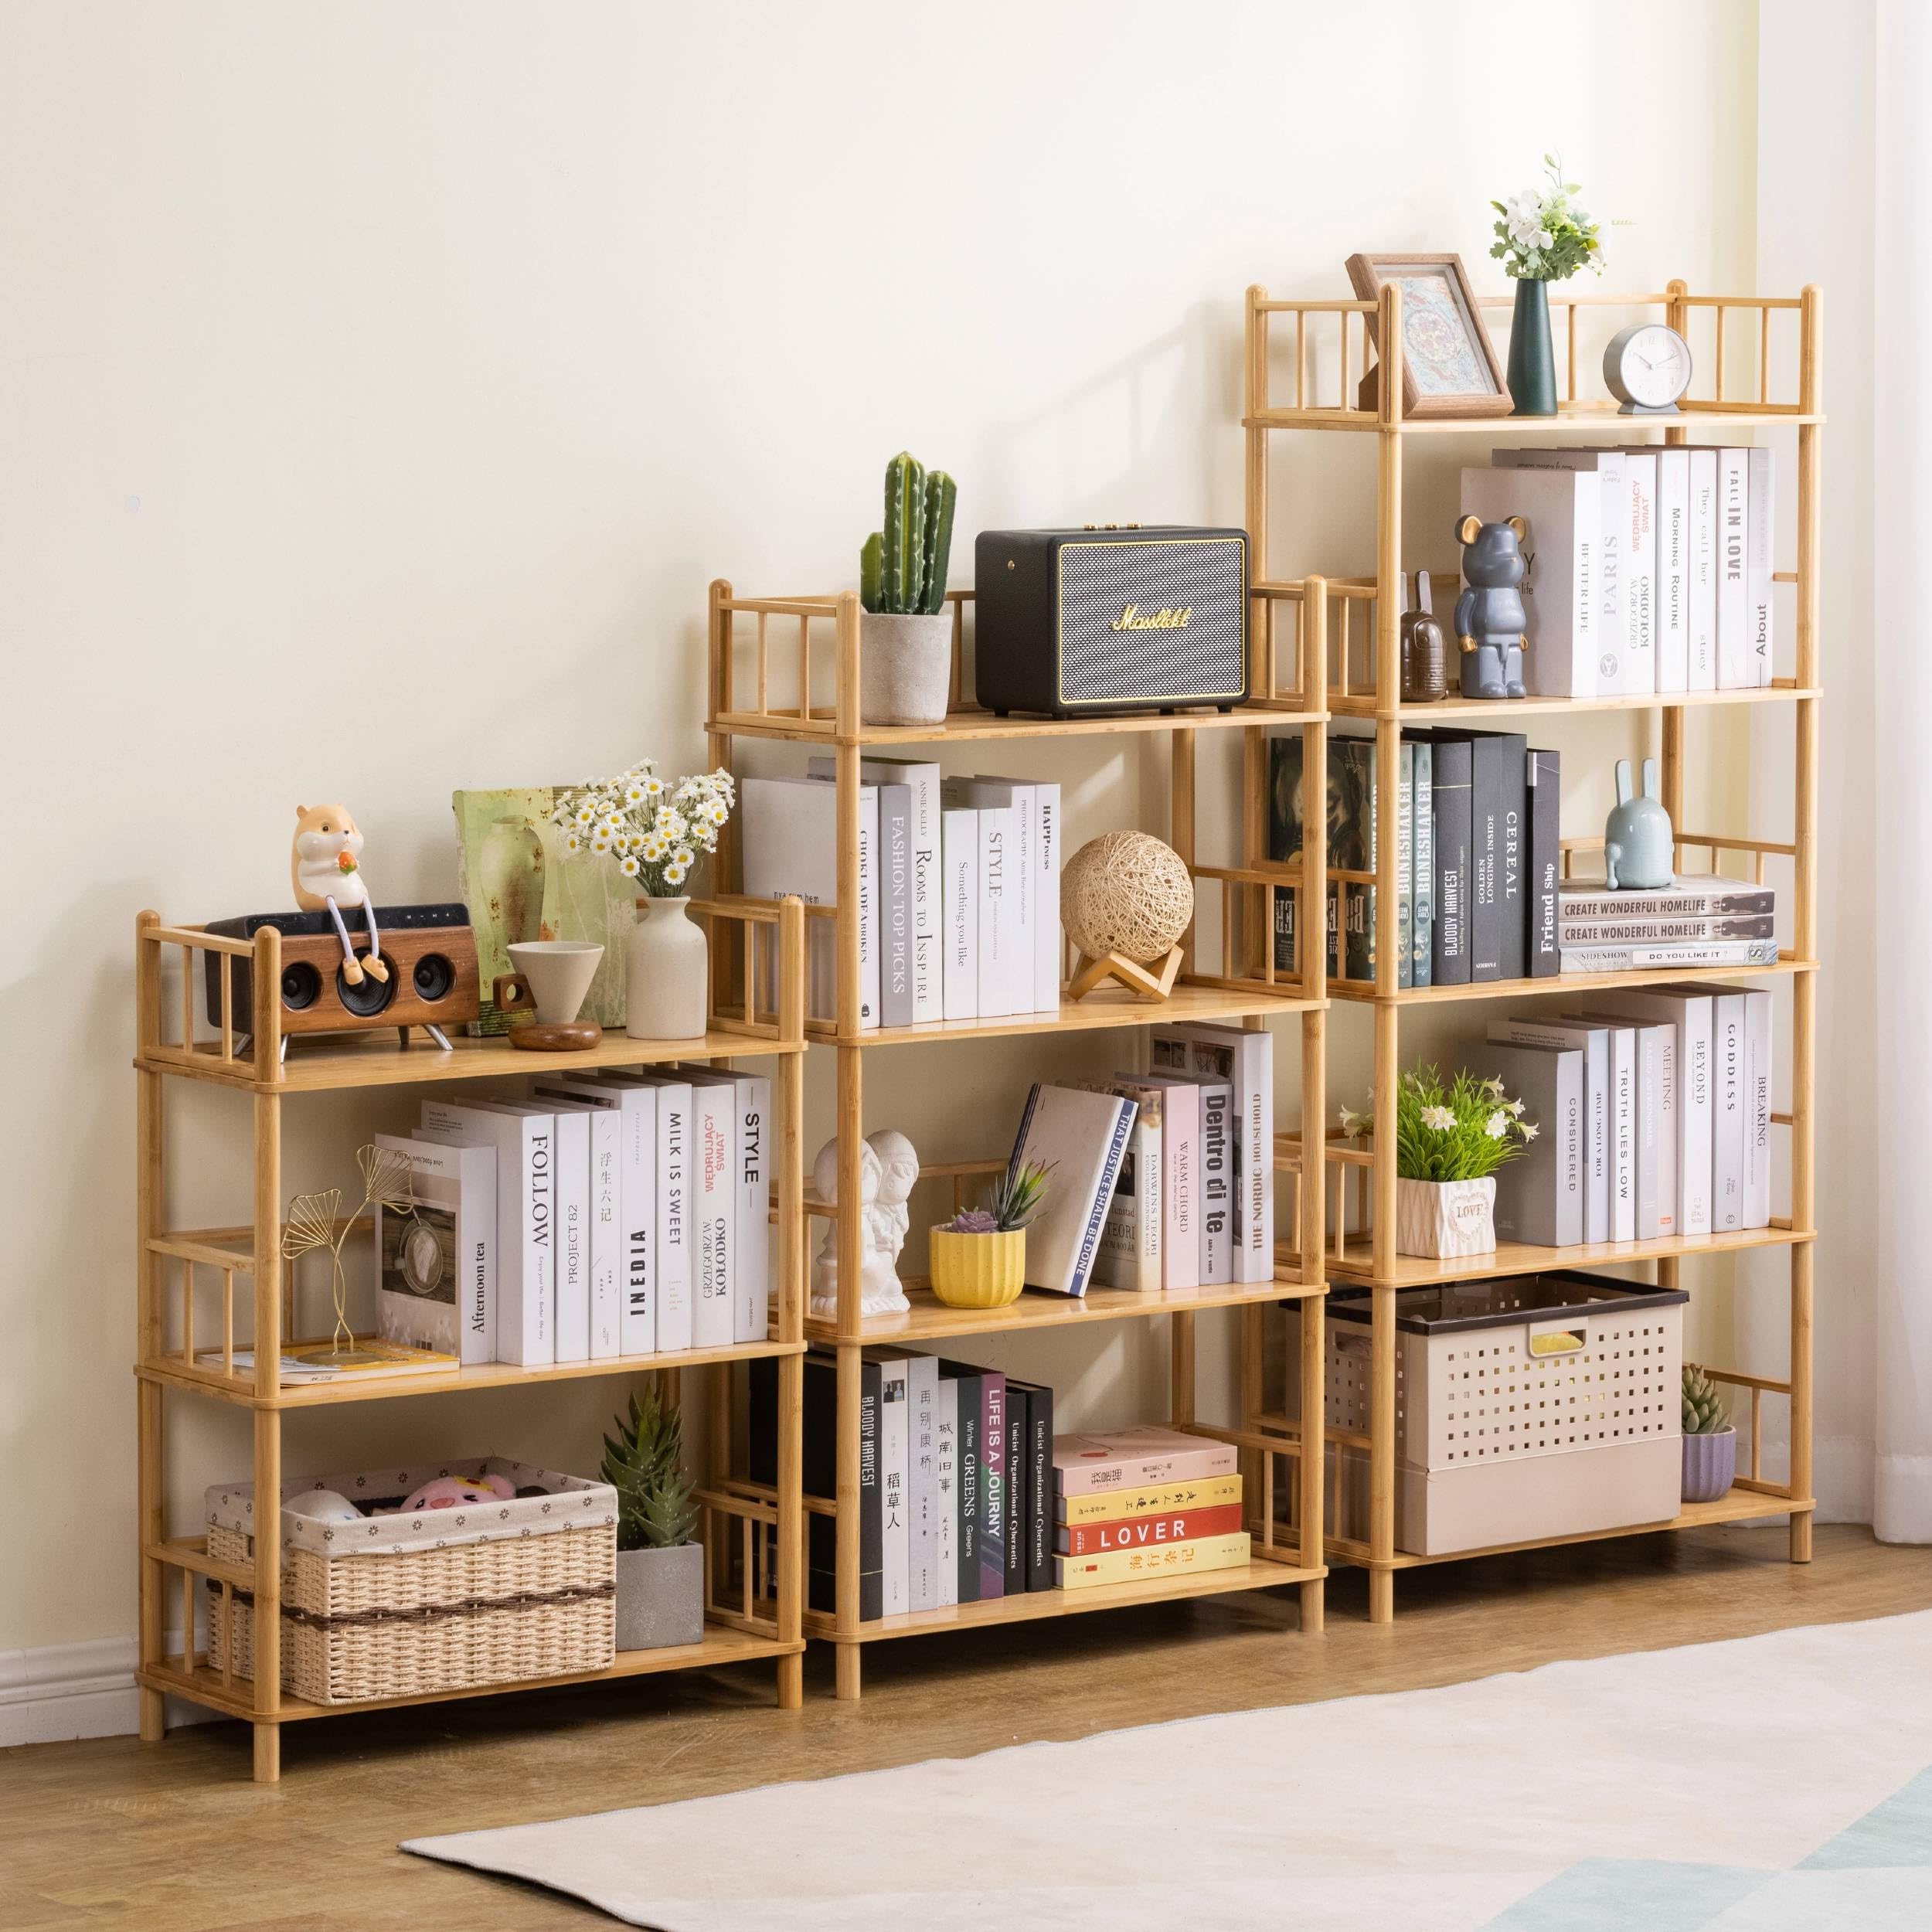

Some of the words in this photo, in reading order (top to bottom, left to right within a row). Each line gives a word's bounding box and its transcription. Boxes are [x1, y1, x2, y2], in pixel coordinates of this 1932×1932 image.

[1700, 487, 1709, 517] They
[1730, 470, 1738, 502] FALL
[1672, 508, 1681, 568] MORNING
[1728, 508, 1740, 526] IN
[1580, 543, 1589, 597] BETTER
[1603, 536, 1618, 616] PARIS
[1701, 562, 1709, 586] her
[1728, 536, 1740, 580] LOVE
[1521, 582, 1534, 595] life
[1671, 575, 1681, 630] ROUTINE
[1580, 604, 1589, 634] LIFE
[1755, 603, 1767, 656] About
[892, 816, 903, 896] FASHION
[1417, 781, 1431, 894] BONESHAKER
[1505, 811, 1517, 899] CEREAL
[988, 832, 1002, 898] STYLE
[1544, 863, 1554, 889] Ship
[774, 890, 786, 901] nya
[805, 893, 819, 903] hem
[957, 861, 968, 922] Something
[1444, 869, 1458, 917] HARVEST
[1565, 903, 1597, 916] CREATE
[1600, 901, 1657, 914] WONDERFUL
[1660, 900, 1706, 913] HOMELIFE
[892, 901, 904, 936] TOP
[956, 925, 965, 944] you
[1444, 918, 1458, 956] BLOODY
[1541, 893, 1554, 954] Friend
[1565, 928, 1597, 940] CREATE
[1600, 925, 1658, 938] WONDERFUL
[1661, 923, 1706, 936] HOMELIFE
[893, 941, 905, 994] PICKS
[957, 947, 968, 967] like
[1581, 951, 1628, 960] SIDESHOW
[1662, 1045, 1672, 1111] MEETING
[1696, 1040, 1706, 1104] BEYOND
[1727, 1024, 1736, 1111] GODDESS
[669, 1113, 681, 1156] MILK
[1115, 1114, 1131, 1144] THAT
[1206, 1094, 1226, 1172] Dentro
[1253, 1094, 1261, 1162] HOUSEHOLD
[1757, 1077, 1767, 1147] BREAKING
[745, 1113, 759, 1184] STYLE
[1101, 1144, 1121, 1191] JUSTICE
[1179, 1141, 1188, 1183] WARM
[532, 1134, 549, 1247] FOLLOW
[600, 1151, 612, 1223] 浮生六记
[669, 1165, 681, 1181] IS
[1206, 1179, 1226, 1200] di
[1253, 1168, 1263, 1220] NORDIC
[568, 1204, 578, 1223] 82
[669, 1189, 681, 1245] SWEET
[1090, 1191, 1107, 1225] SHALL
[1106, 1222, 1135, 1240] TEORI
[1179, 1185, 1188, 1233] CHORD
[1206, 1211, 1226, 1233] te
[1457, 1203, 1484, 1218] LOVE
[472, 1242, 485, 1261] tea
[568, 1228, 578, 1284] PROJECT
[716, 1217, 726, 1298] KOŁODKO
[1085, 1225, 1097, 1242] BE
[1252, 1224, 1263, 1251] THE
[630, 1230, 646, 1316] INEDIA
[702, 1234, 713, 1298] GRZEGORZ
[1076, 1241, 1095, 1275] DONE
[471, 1266, 485, 1334] Afternoon
[862, 1396, 874, 1434] BLOODY
[920, 1389, 932, 1475] 再别康桥
[988, 1389, 1001, 1427] LIFE
[938, 1421, 954, 1493] 城南旧事
[966, 1420, 975, 1447] Winter
[988, 1430, 1001, 1447] IS
[988, 1449, 1001, 1464] A
[862, 1437, 875, 1487] HARVEST
[964, 1453, 975, 1517] GREENS
[1036, 1454, 1044, 1515] Organizational
[886, 1471, 900, 1529] 稻草人
[988, 1466, 1001, 1537] JOURNY
[1009, 1520, 1019, 1570] Cybernetics
[1035, 1518, 1043, 1567] Cybernetics
[1100, 1519, 1185, 1548] LOVER
[1130, 1547, 1195, 1570] 海行杂记
